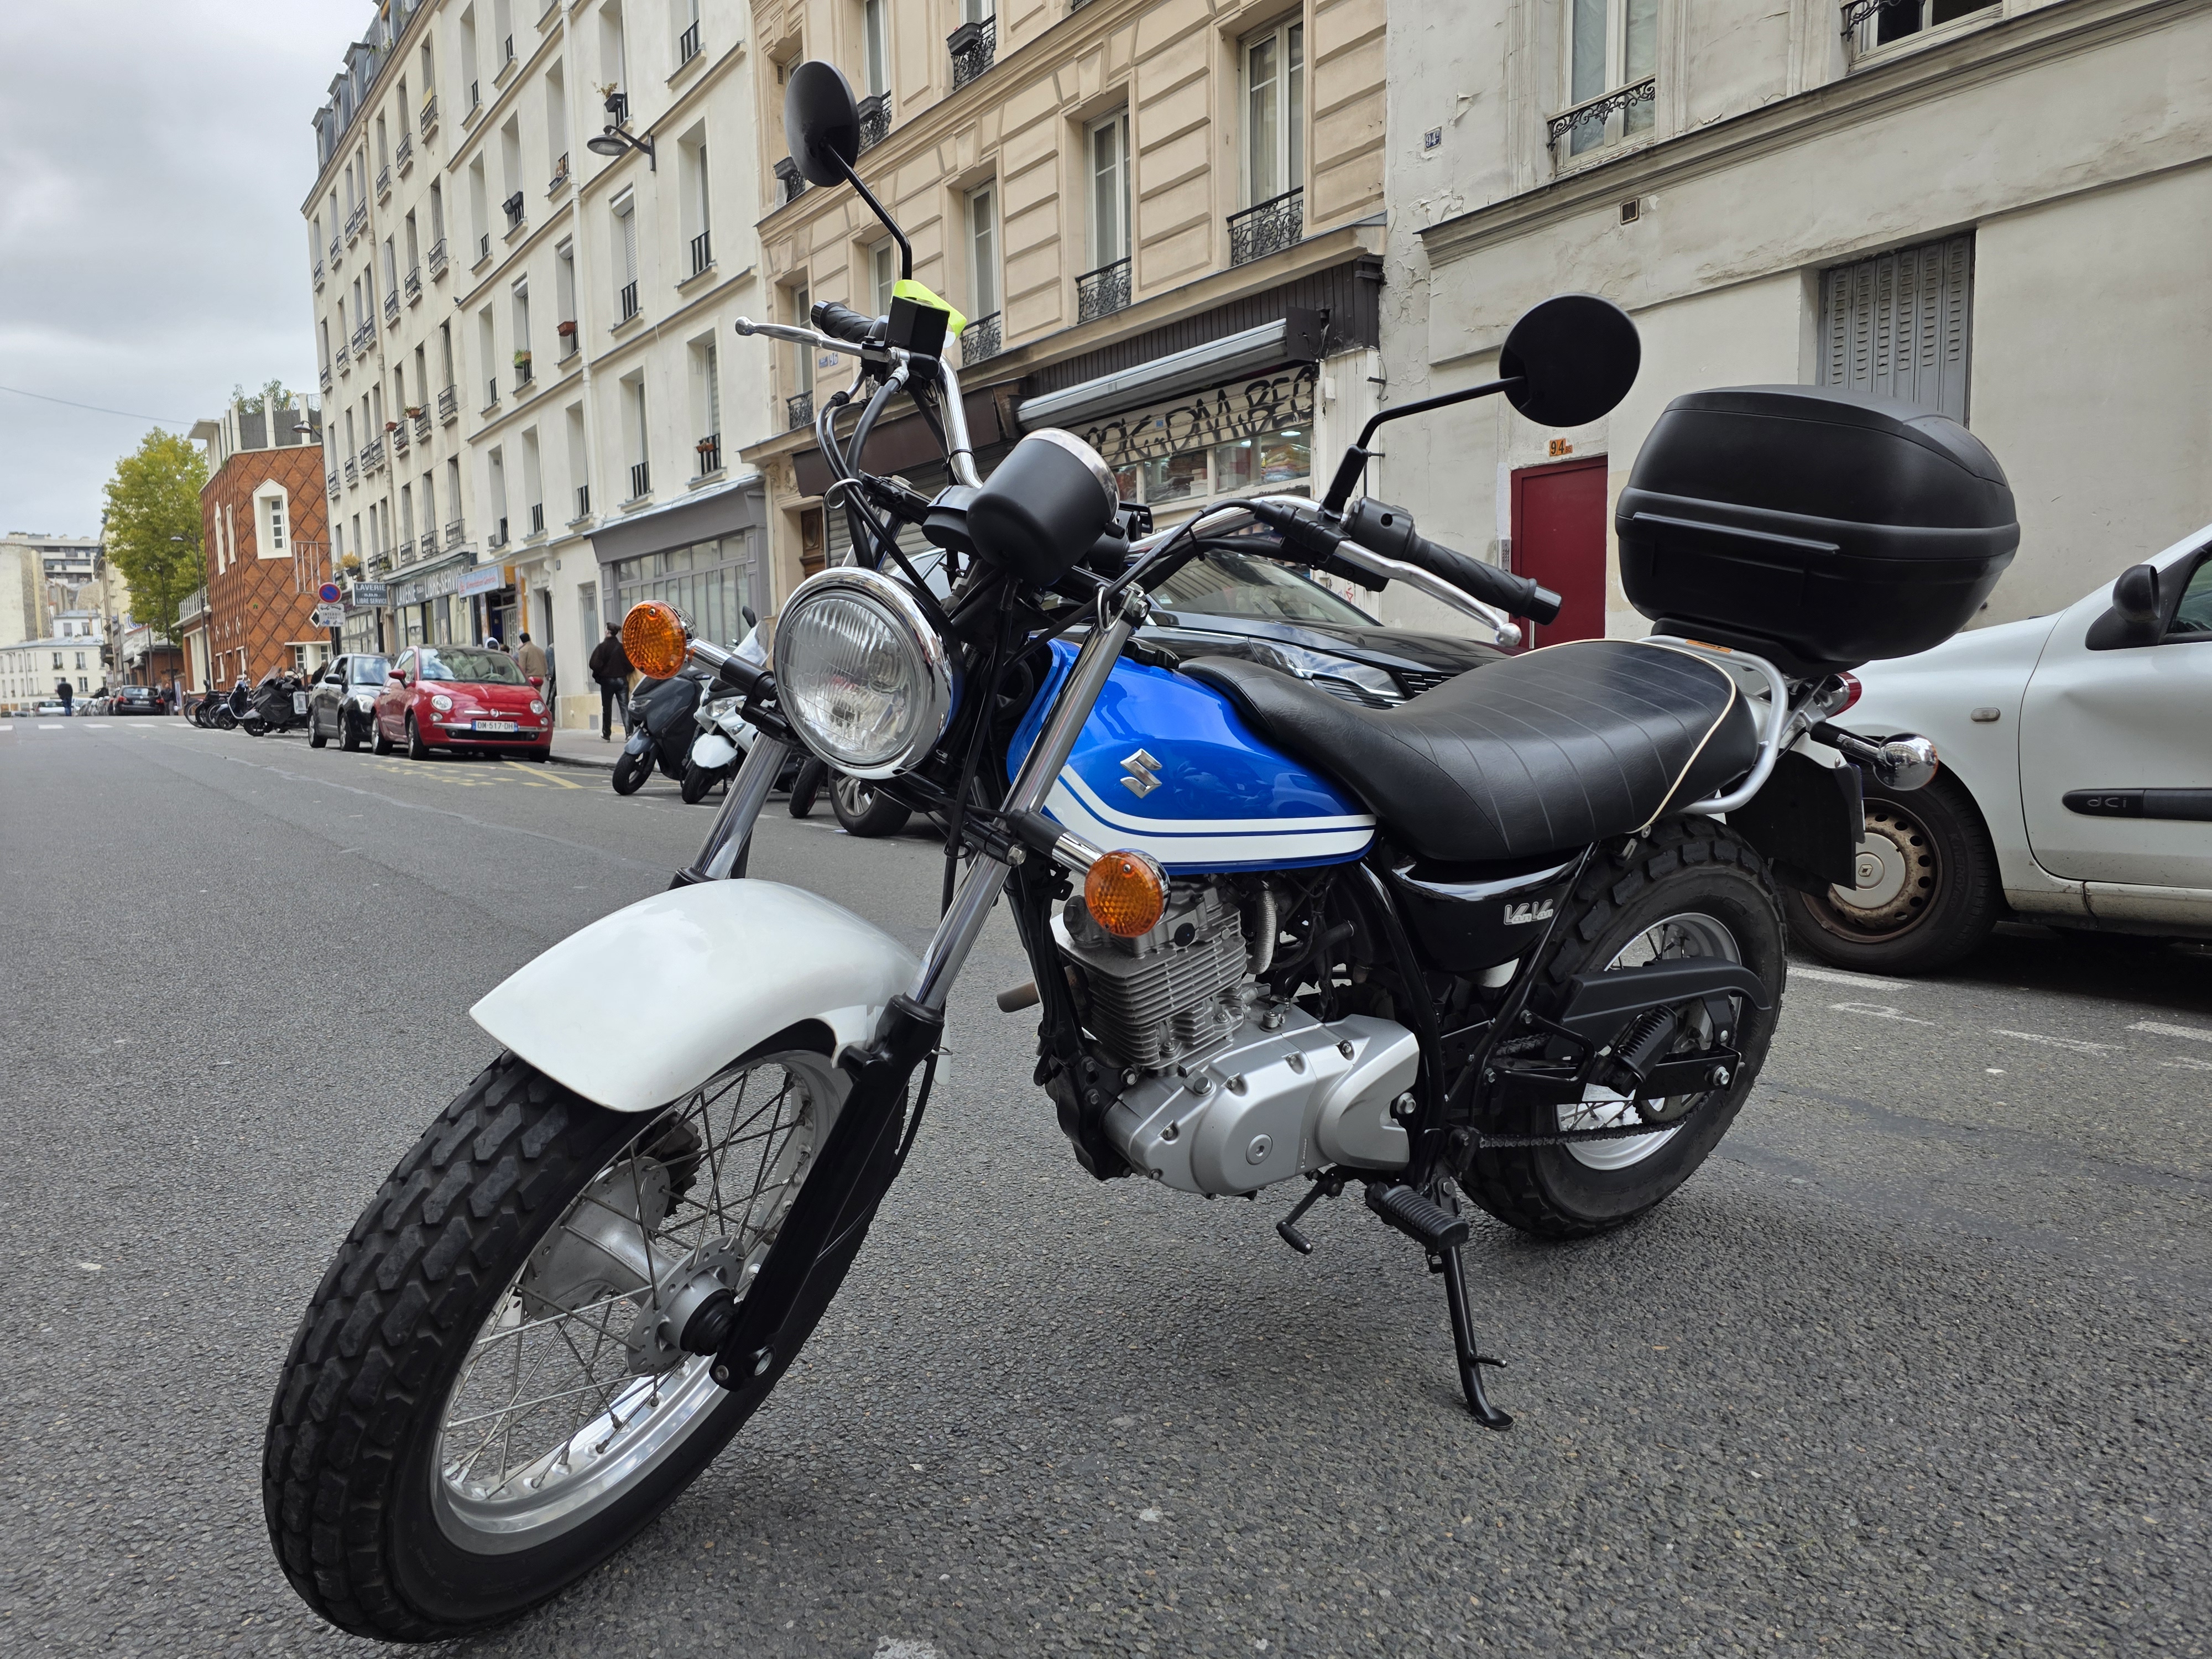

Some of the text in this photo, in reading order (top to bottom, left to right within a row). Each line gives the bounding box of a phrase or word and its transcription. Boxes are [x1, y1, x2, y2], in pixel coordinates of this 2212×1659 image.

[830, 352, 838, 366] 96
[1551, 440, 1564, 455] 94
[396, 582, 416, 606] LAVERIE
